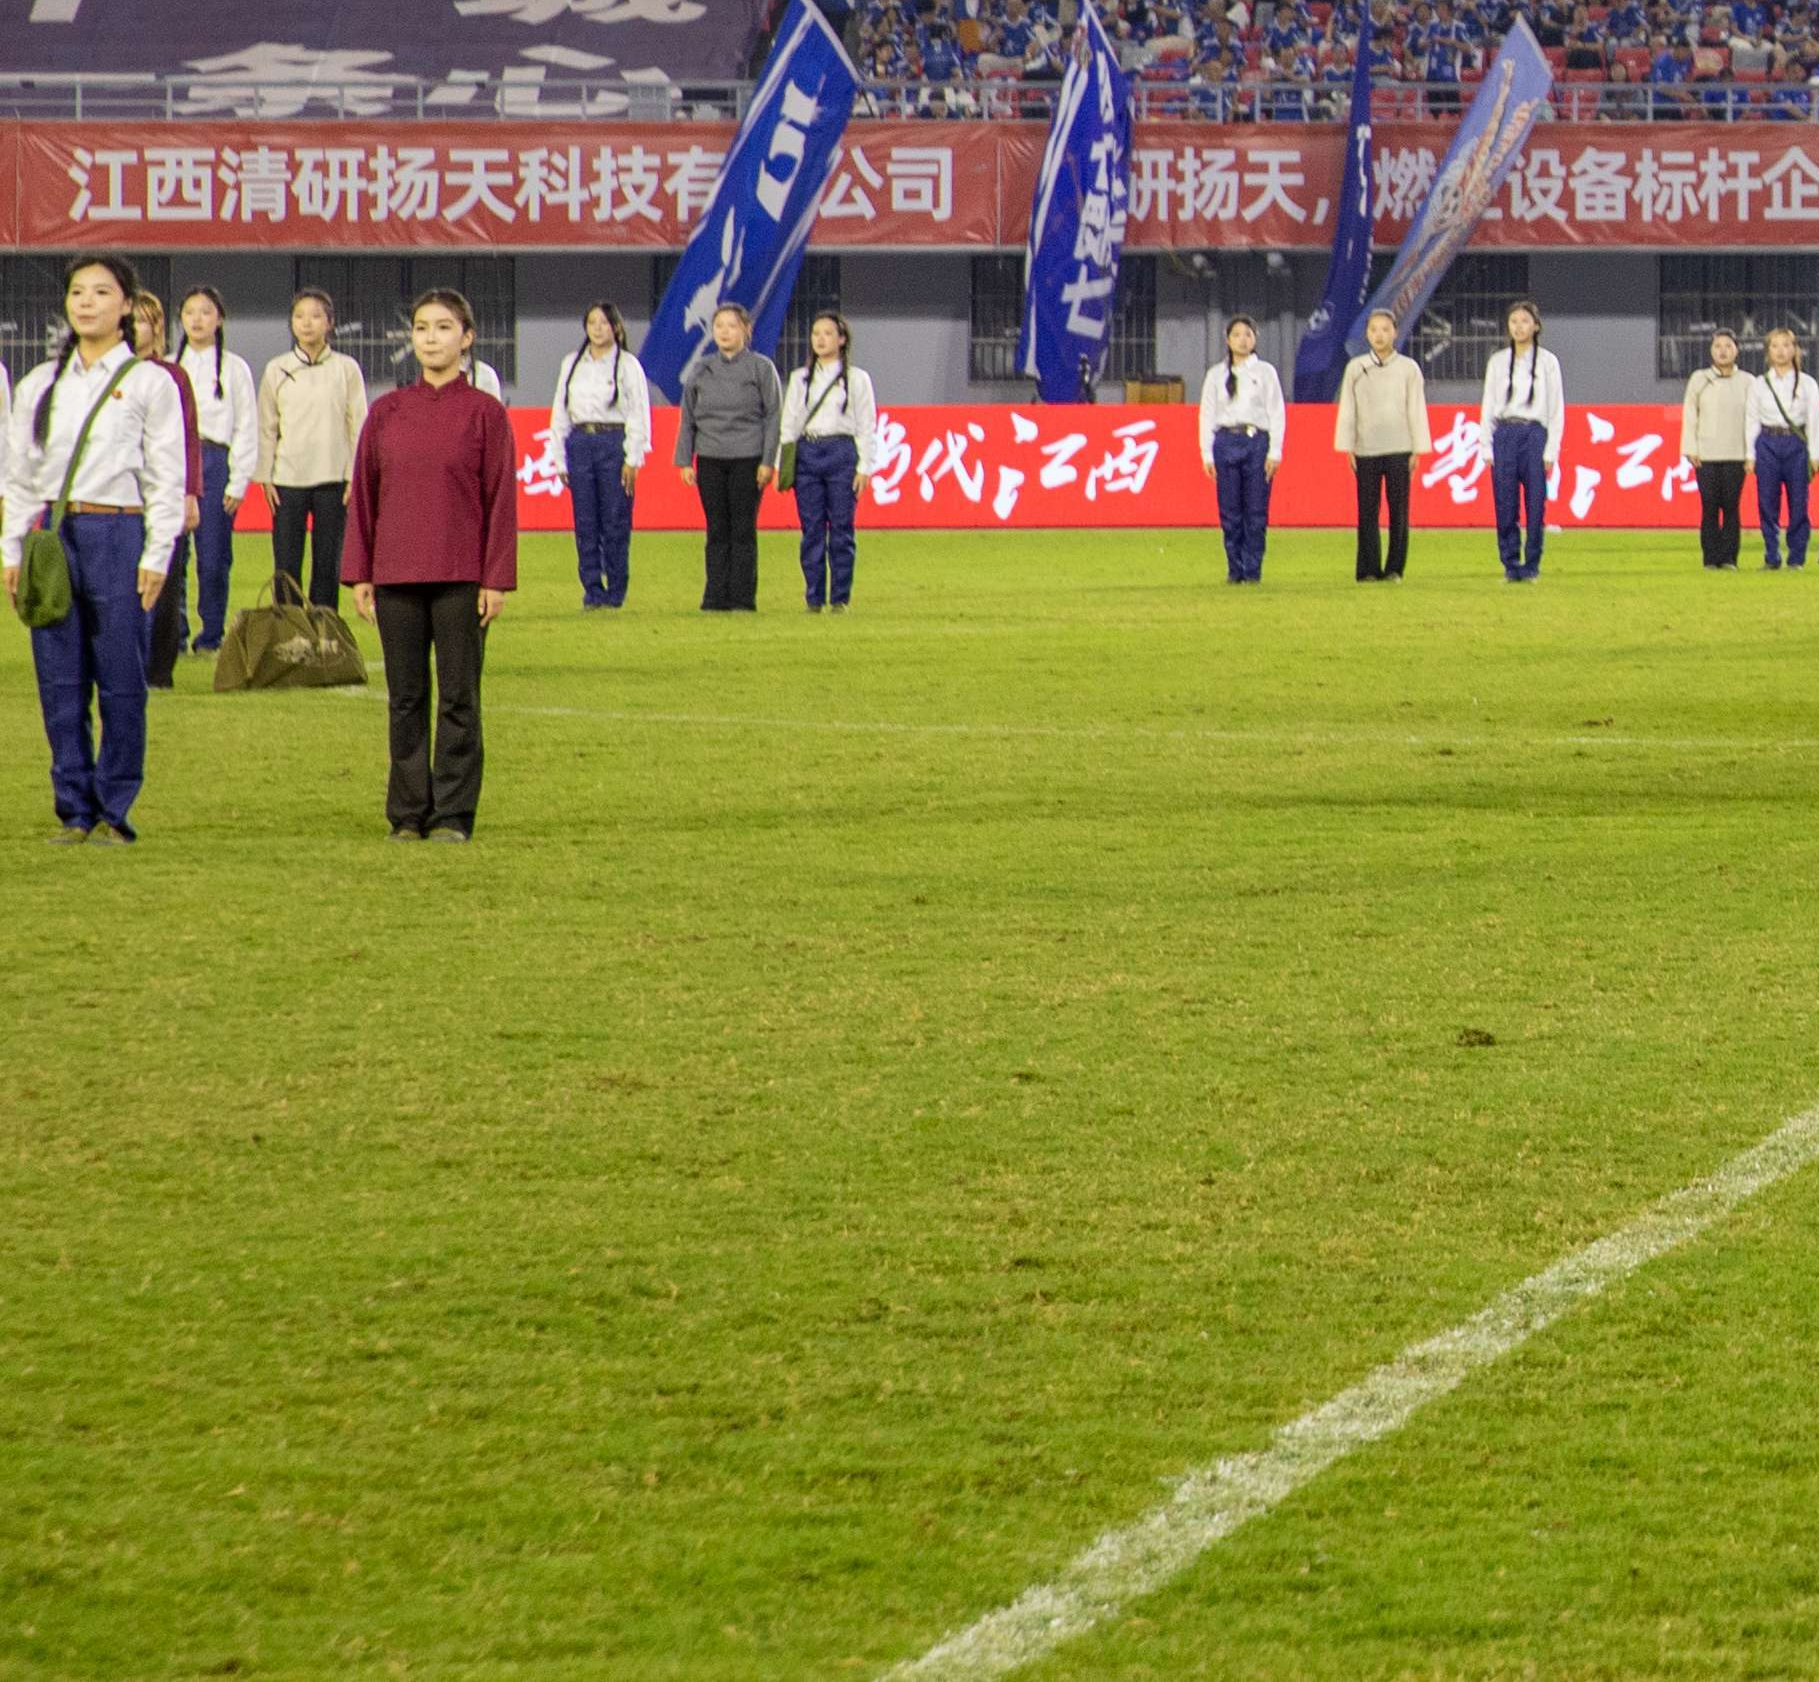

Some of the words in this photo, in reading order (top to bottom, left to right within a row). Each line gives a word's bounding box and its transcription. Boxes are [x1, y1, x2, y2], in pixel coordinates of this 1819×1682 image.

[68, 144, 954, 224] 江西清研扬天科技有公司
